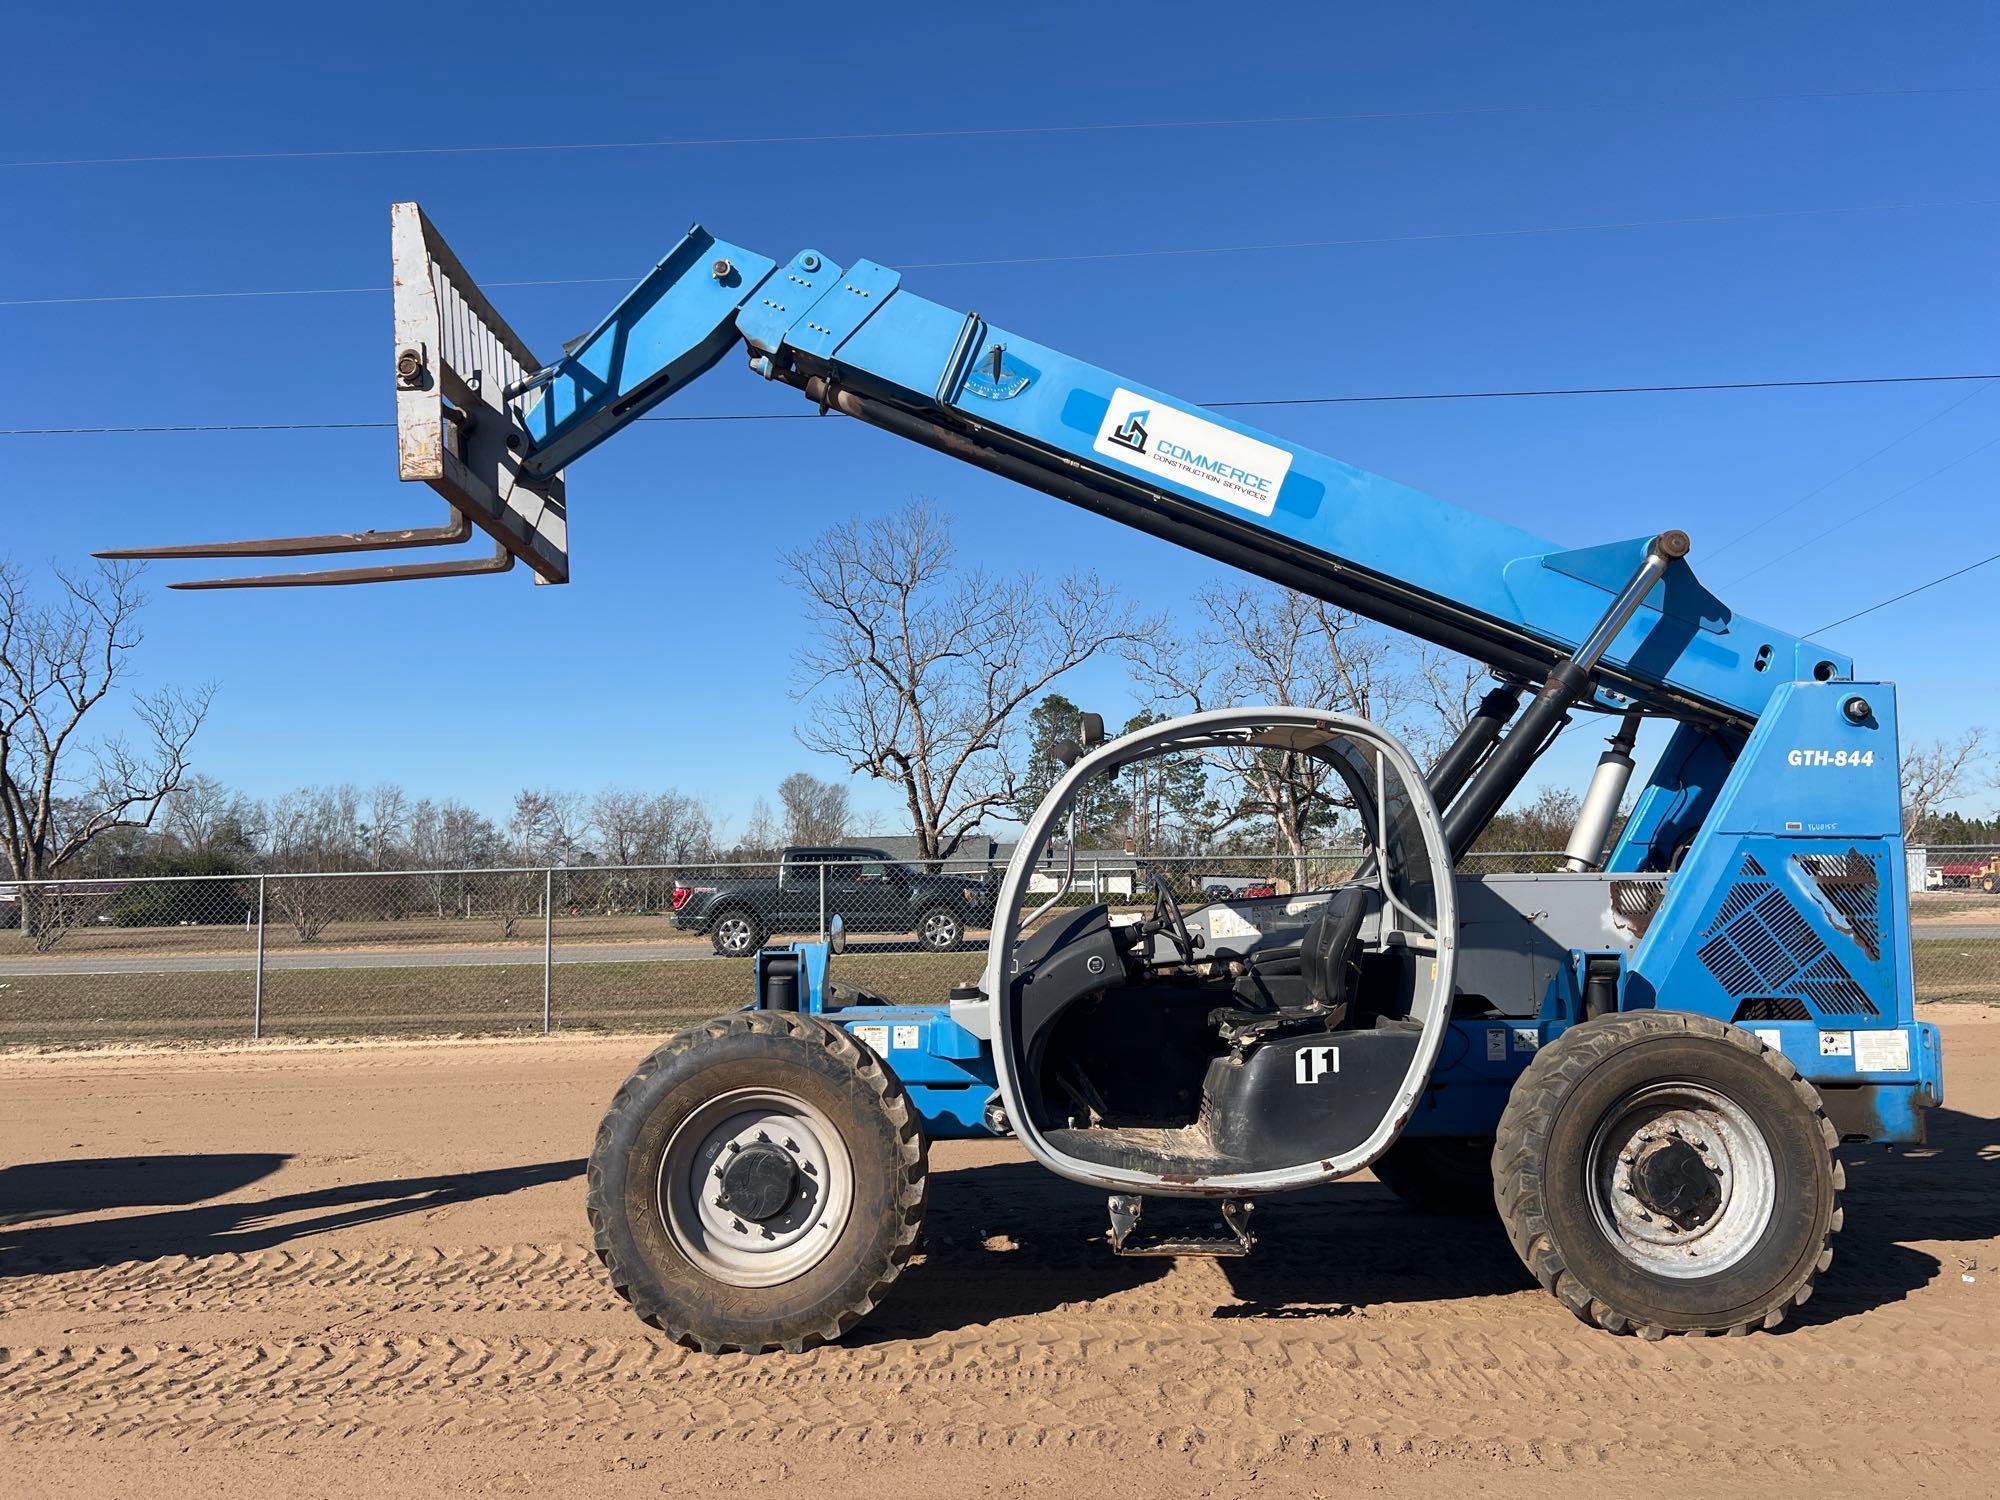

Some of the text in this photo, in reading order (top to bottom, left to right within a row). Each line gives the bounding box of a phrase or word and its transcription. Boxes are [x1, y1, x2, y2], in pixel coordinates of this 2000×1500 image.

[1153, 453, 1267, 501] CONSTRUCTION SERVICES
[1156, 440, 1272, 493] COMMERCE
[1787, 750, 1875, 767] GTH-844
